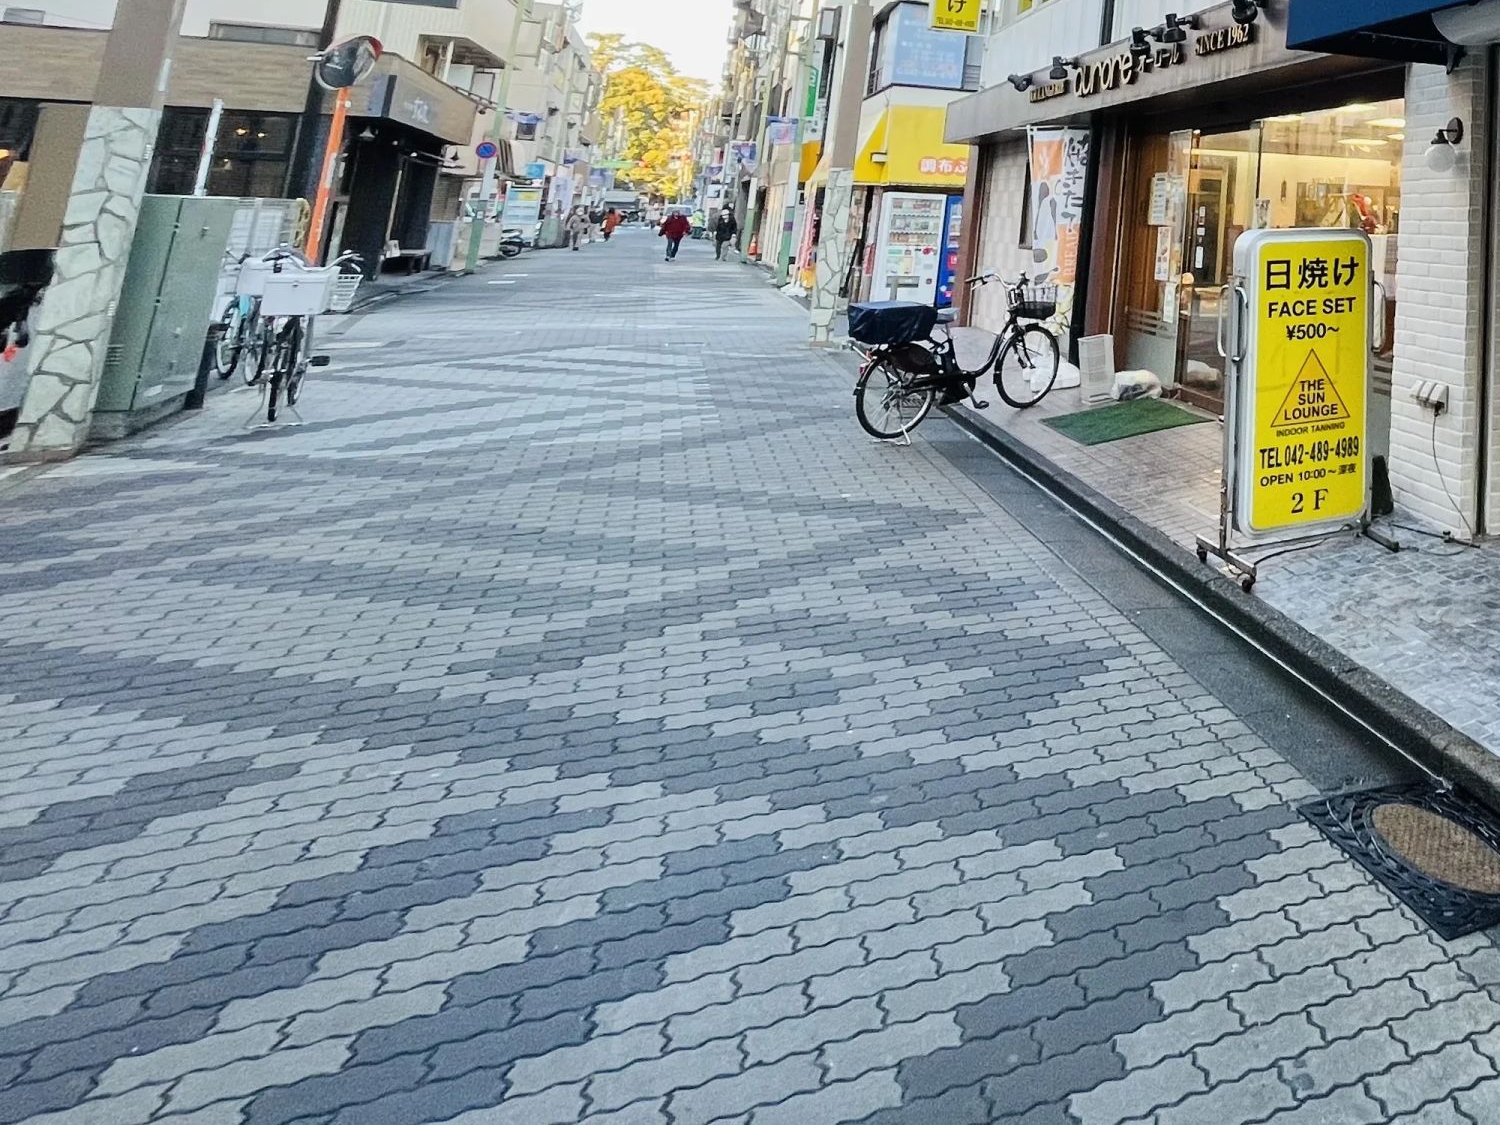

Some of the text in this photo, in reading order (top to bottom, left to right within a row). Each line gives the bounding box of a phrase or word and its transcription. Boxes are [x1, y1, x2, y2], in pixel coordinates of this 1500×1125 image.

[1196, 24, 1249, 56] SINCE 1962
[1074, 53, 1134, 97] aurore
[1265, 256, 1360, 291] 日焼け
[1268, 297, 1357, 318] FACE SET
[1299, 379, 1326, 391] THE
[1298, 392, 1325, 406] SUN
[1284, 405, 1338, 421] LOUNGE
[1276, 422, 1345, 437] INDOOR TANNING
[1260, 436, 1360, 469] TEL 042-489-4989
[1260, 473, 1293, 487] OPEN
